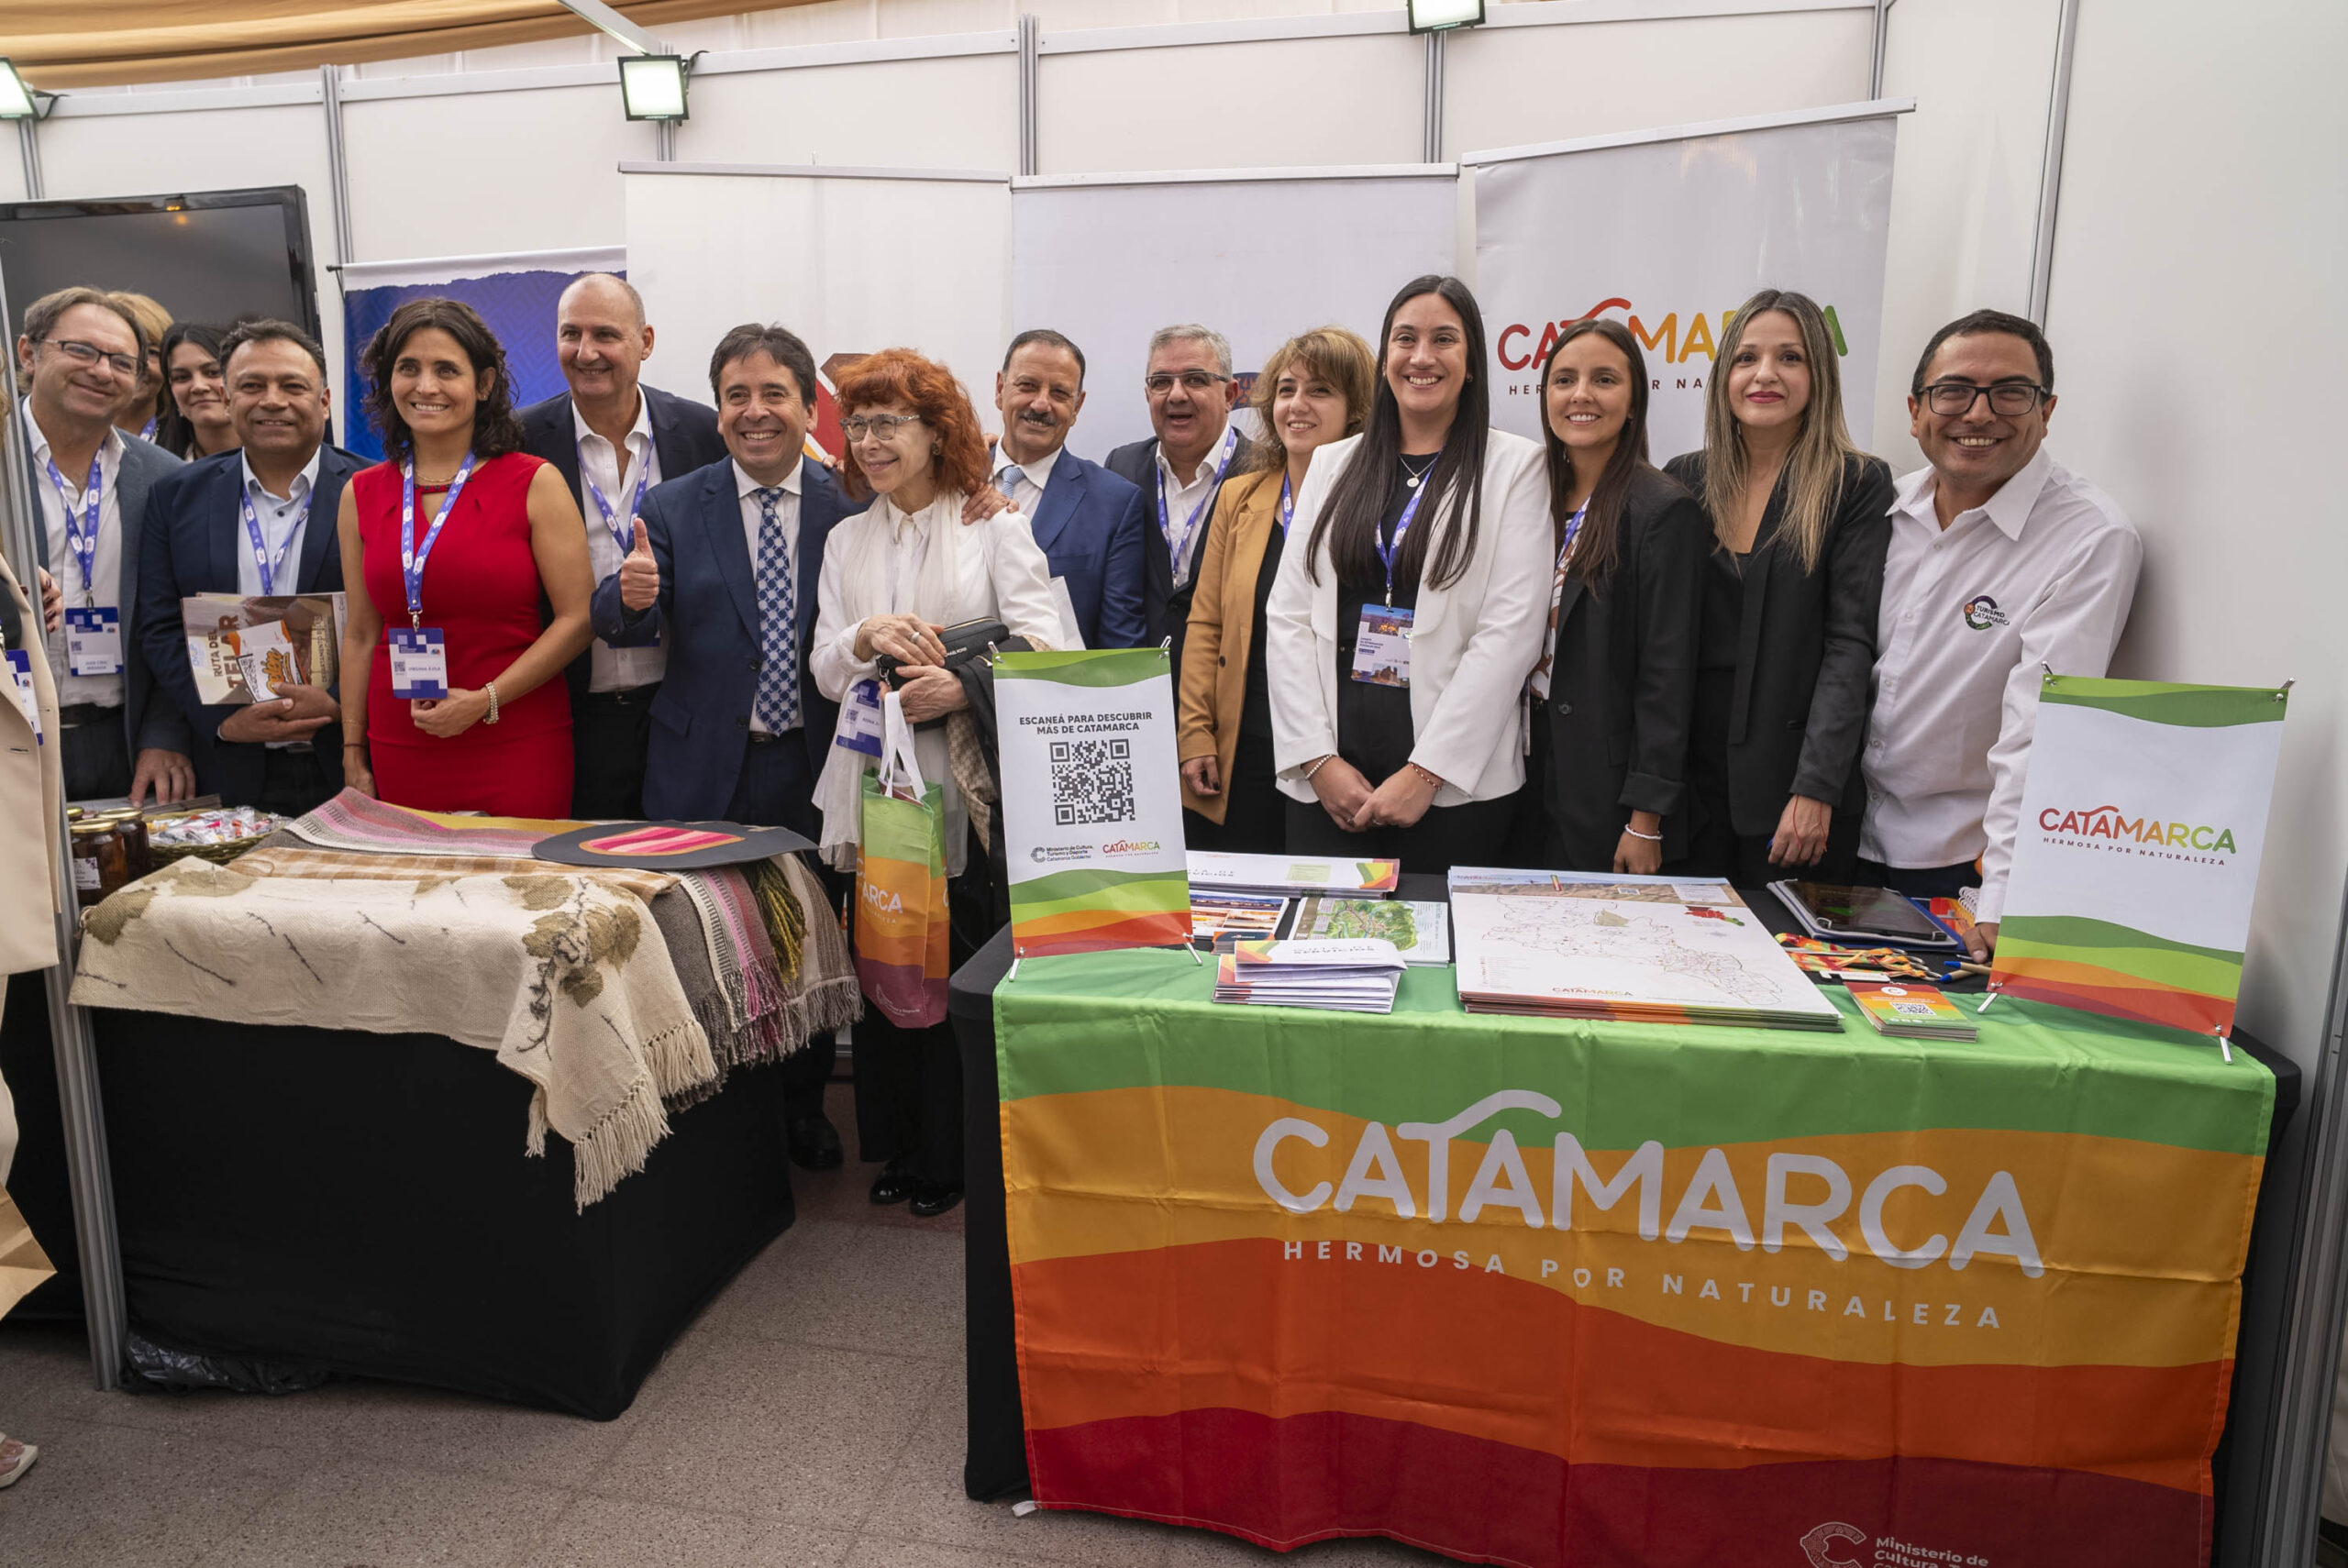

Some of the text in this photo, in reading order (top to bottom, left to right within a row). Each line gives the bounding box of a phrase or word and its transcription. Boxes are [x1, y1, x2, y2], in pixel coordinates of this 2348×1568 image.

[1977, 605, 2005, 618] TURISMO
[207, 630, 223, 678] RUTA DEL
[1019, 712, 1152, 725] ESCANEÁ PARA DESCUBRIR
[1036, 723, 1140, 734] MÁS DE CATAMARCA
[2039, 805, 2237, 855] CATAMARCA
[1102, 839, 1160, 854] CATAMARCA
[2043, 836, 2225, 867] HERMOSA POR NATURALEZA
[1253, 1088, 2045, 1279] CATAMARCA
[1284, 1241, 2001, 1330] HERMOSA POR NATURALEZA
[1876, 1537, 1989, 1567] Ministerio de
